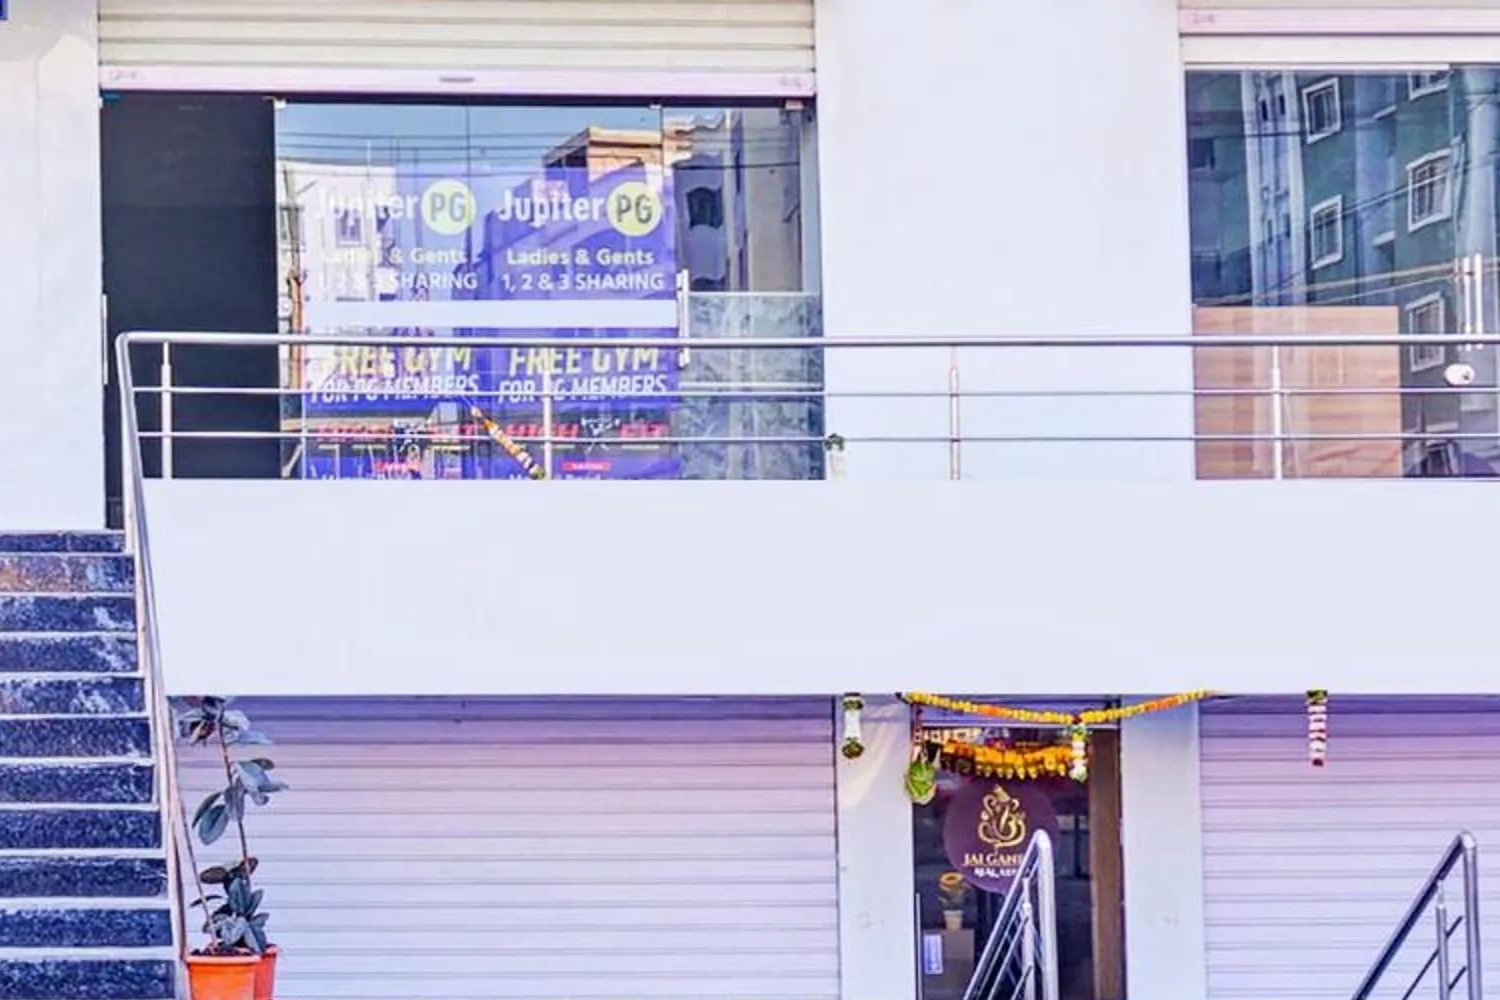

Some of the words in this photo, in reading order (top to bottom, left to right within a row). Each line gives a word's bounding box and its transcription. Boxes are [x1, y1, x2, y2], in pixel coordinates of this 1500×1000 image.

[429, 191, 467, 222] PG
[498, 189, 605, 228] Jupiter
[617, 194, 653, 224] PG
[389, 249, 404, 264] &
[412, 248, 468, 265] Gents
[507, 248, 571, 265] Ladies
[575, 248, 590, 265] &
[596, 248, 655, 265] Gents
[389, 272, 479, 290] SHARING
[502, 273, 515, 293] 1,
[521, 273, 533, 290] 2
[539, 273, 553, 290] &
[558, 273, 570, 291] 3
[575, 273, 665, 290] SHARING
[383, 374, 481, 400] MEMBERS
[498, 379, 536, 404] FOR
[570, 374, 668, 401] MEMBERS
